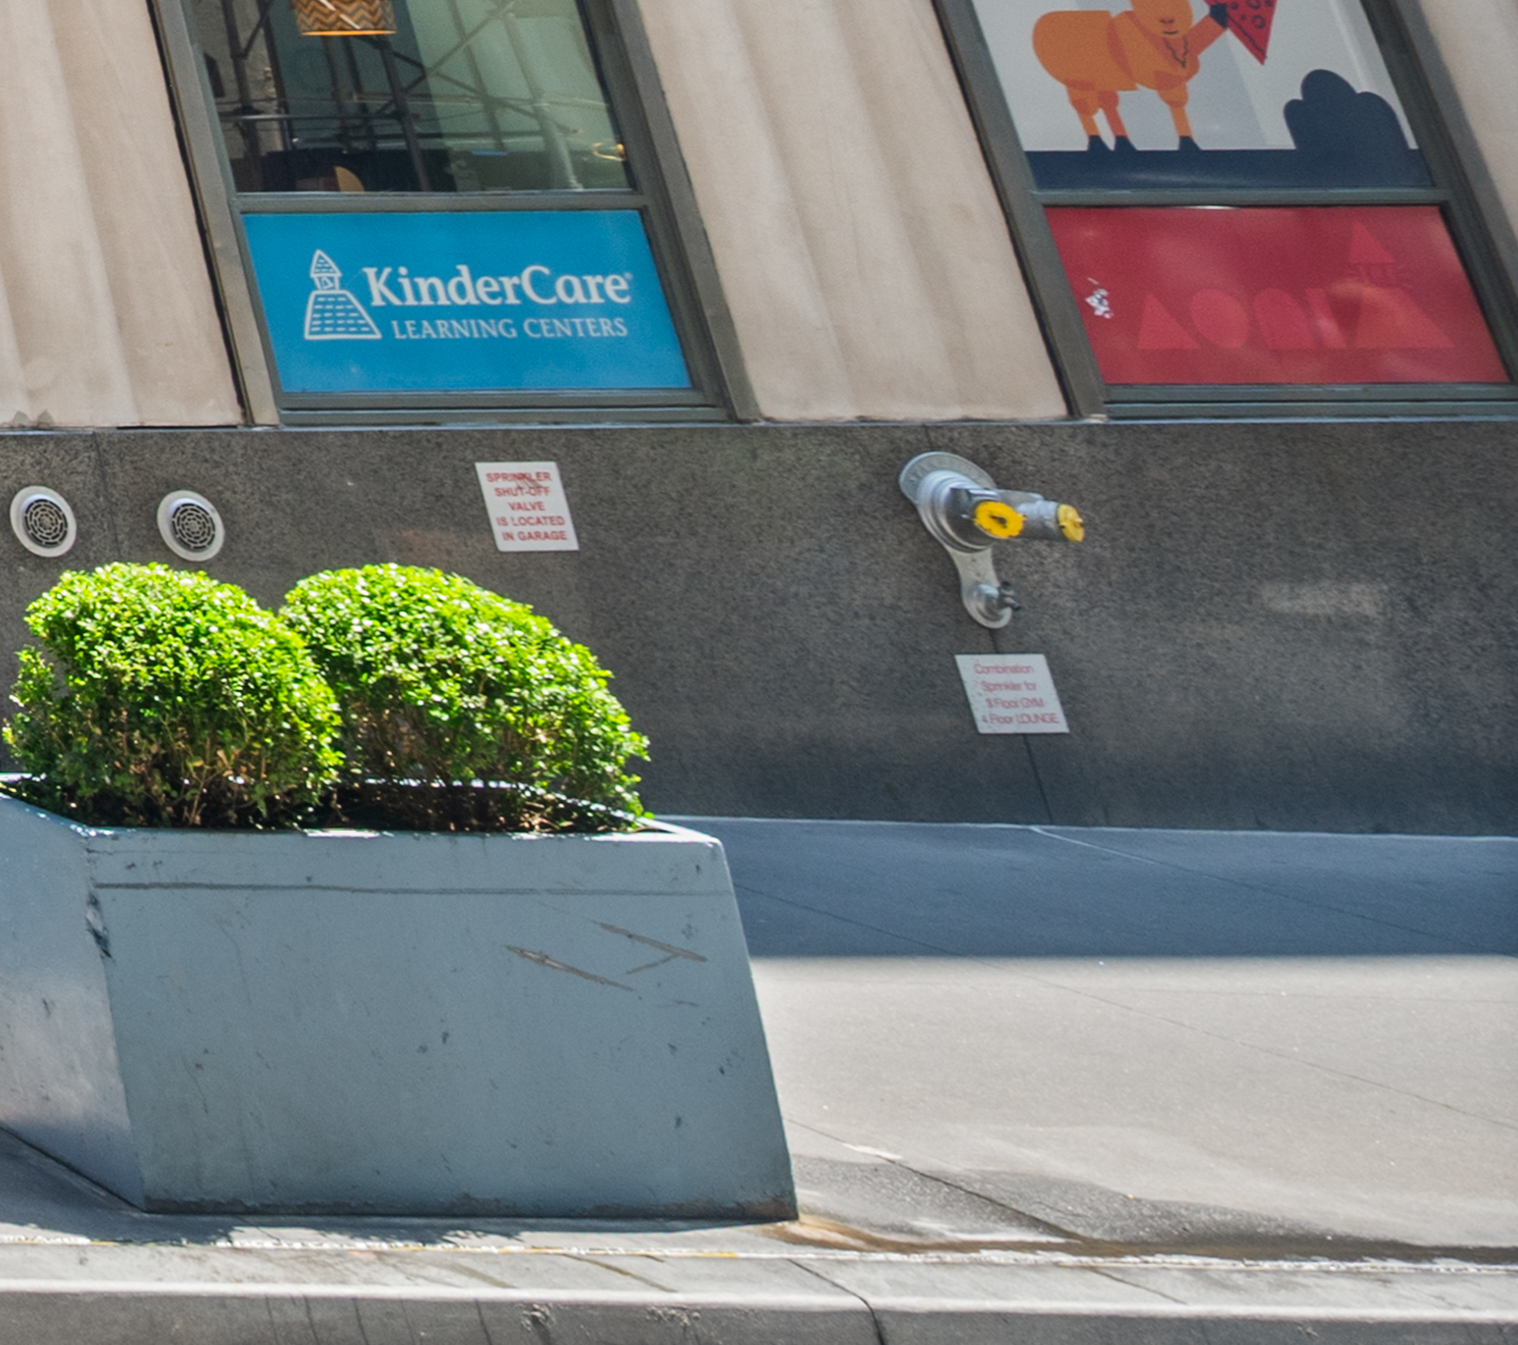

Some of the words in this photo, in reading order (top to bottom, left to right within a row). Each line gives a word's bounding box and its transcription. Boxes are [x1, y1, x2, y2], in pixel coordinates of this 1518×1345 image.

[361, 264, 632, 306] KinderCare
[391, 319, 518, 339] LEARNING
[523, 317, 628, 337] CENTERS
[495, 487, 551, 496] SHUT-OFF
[508, 502, 545, 511] VALVE
[496, 517, 508, 526] IS
[511, 516, 565, 526] LOCATED
[502, 531, 514, 541] IN
[517, 531, 567, 541] GARAGE
[1016, 713, 1059, 724] LOUNGE
